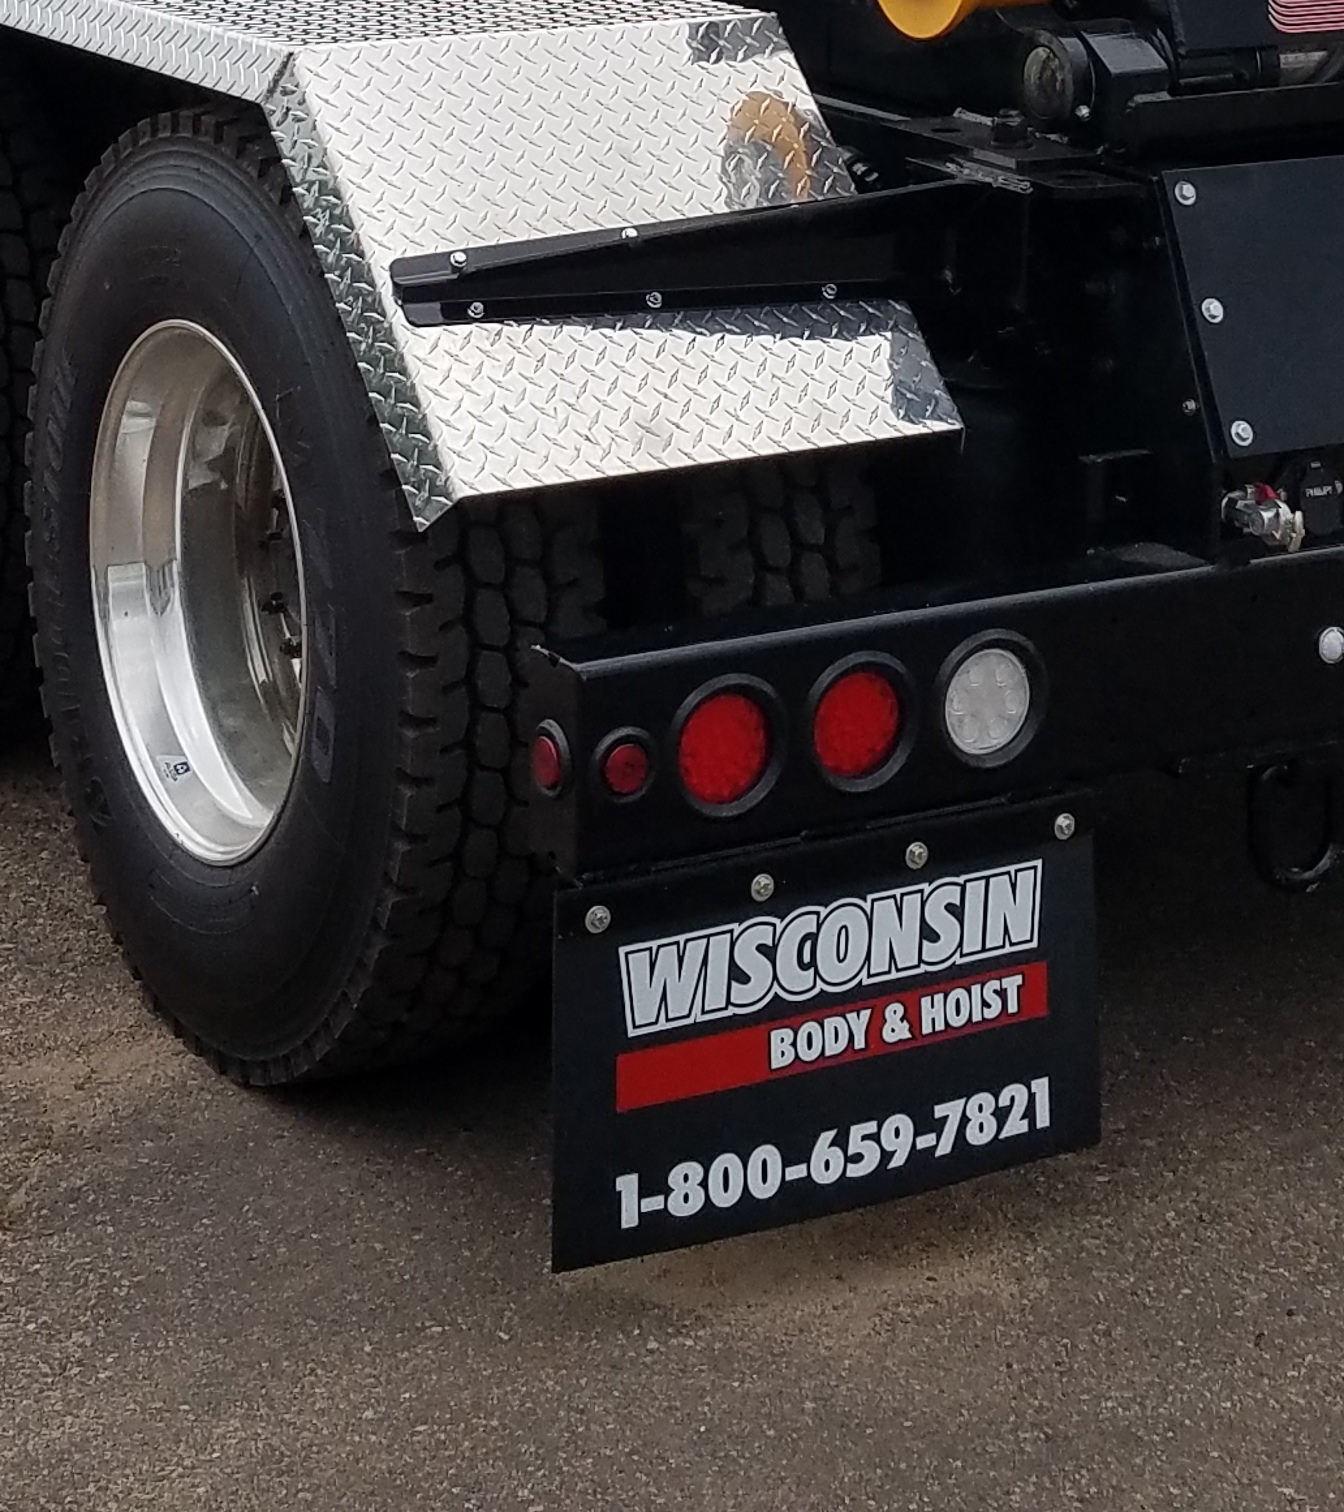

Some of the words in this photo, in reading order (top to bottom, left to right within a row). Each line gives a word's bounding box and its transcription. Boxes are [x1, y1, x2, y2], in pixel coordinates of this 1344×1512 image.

[619, 859, 1042, 1037] WISCONSIN
[770, 1010, 872, 1069] BODY
[882, 1003, 912, 1044] &
[921, 975, 1024, 1035] HOIST
[616, 1077, 1051, 1229] 1-800-659-7821
